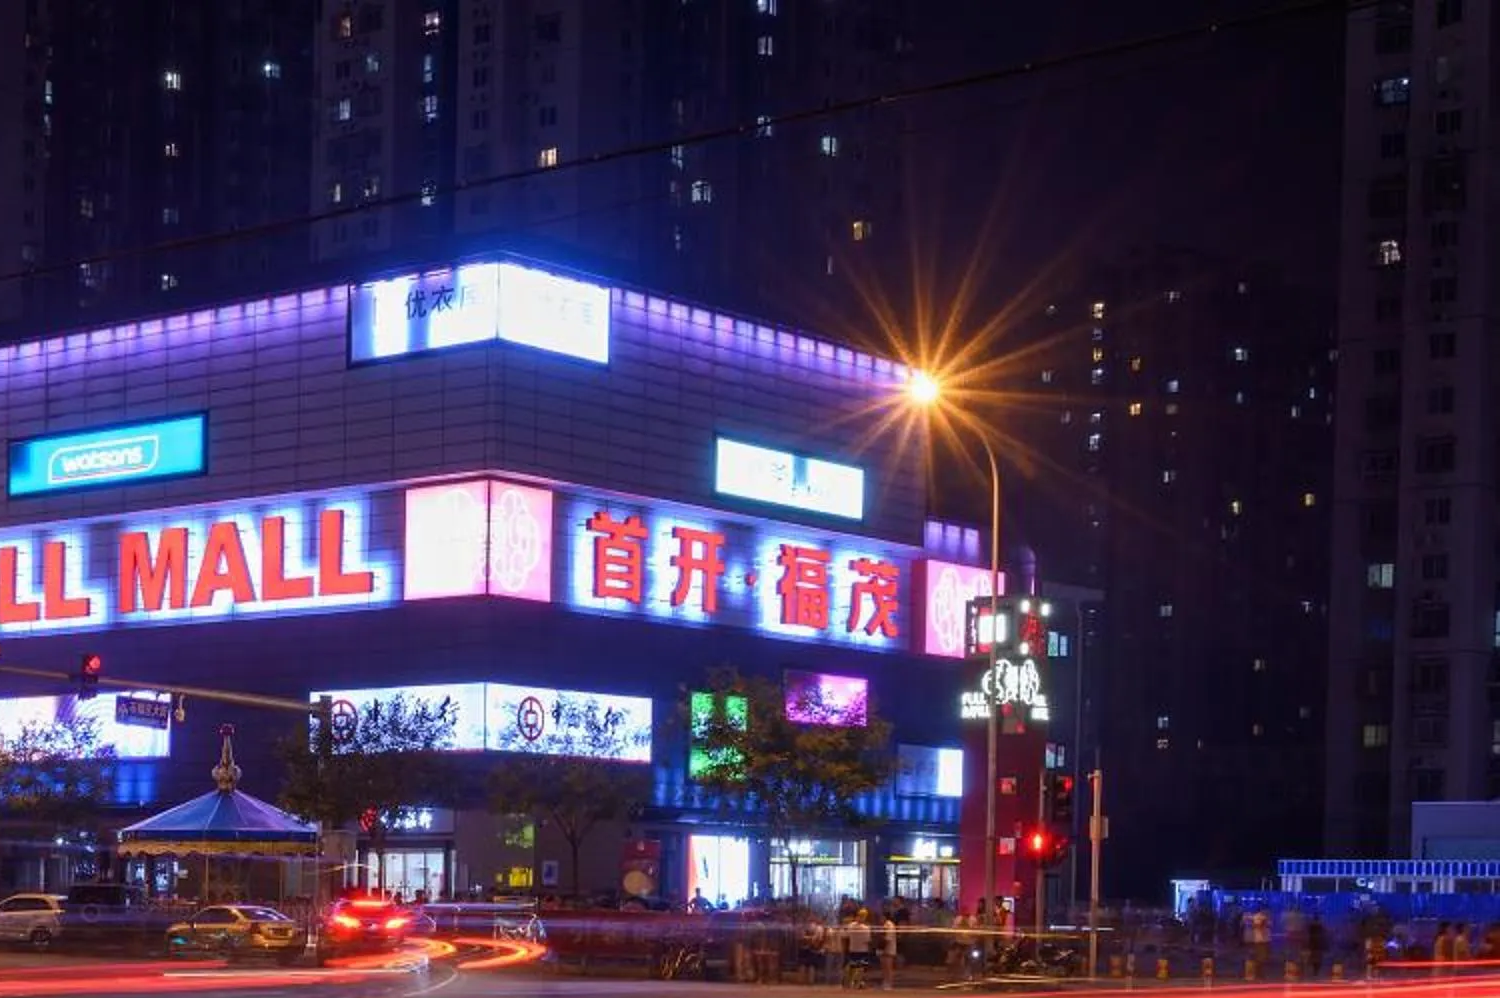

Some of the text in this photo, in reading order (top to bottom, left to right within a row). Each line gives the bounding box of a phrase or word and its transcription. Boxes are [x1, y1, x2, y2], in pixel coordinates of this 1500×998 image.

[61, 444, 143, 474] watsons
[118, 509, 373, 613] MALL
[586, 511, 899, 637] 首开·福茂
